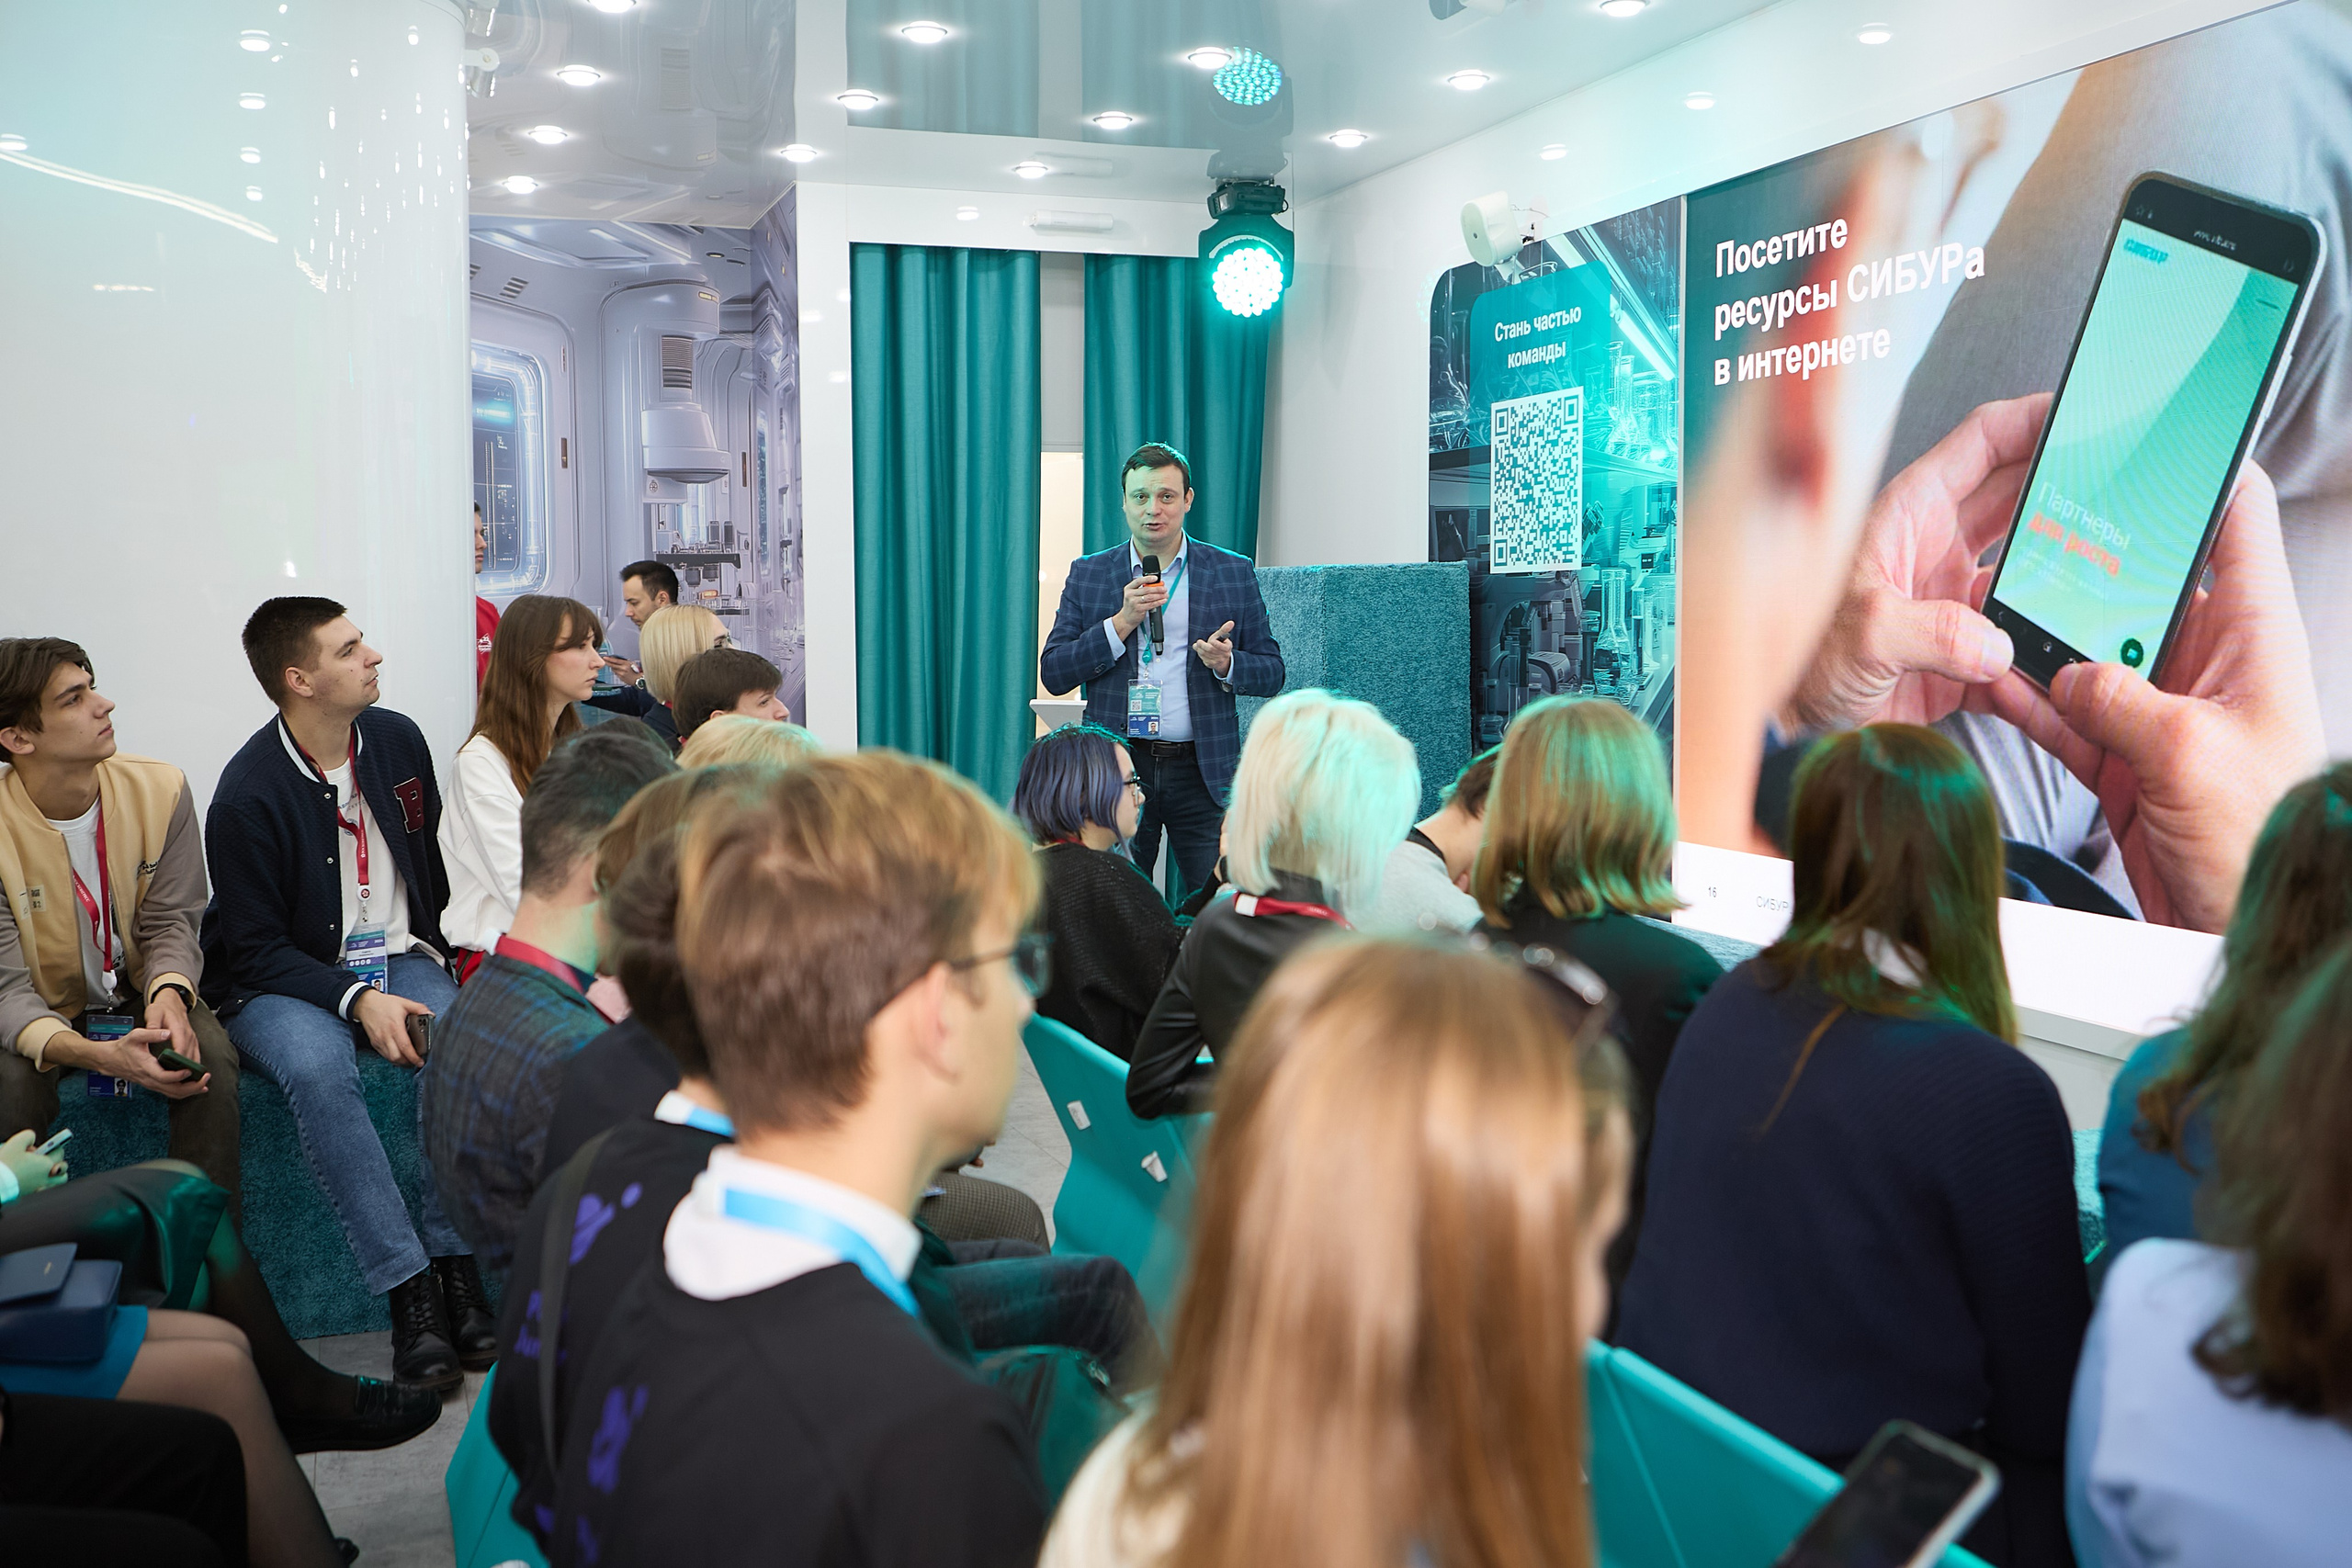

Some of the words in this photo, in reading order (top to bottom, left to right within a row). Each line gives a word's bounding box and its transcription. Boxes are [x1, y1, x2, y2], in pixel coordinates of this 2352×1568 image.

[1715, 218, 1848, 277] Посетите
[1714, 279, 1838, 341] ресурсы
[1847, 242, 1984, 303] СИБУРа
[1494, 320, 1531, 343] Стань
[1533, 306, 1582, 332] частью
[1507, 341, 1566, 368] команды
[1714, 358, 1730, 386] в
[1737, 327, 1891, 380] интернете
[2038, 481, 2131, 550] Партнеры
[2064, 530, 2120, 577] роста
[1708, 886, 1717, 897] 16
